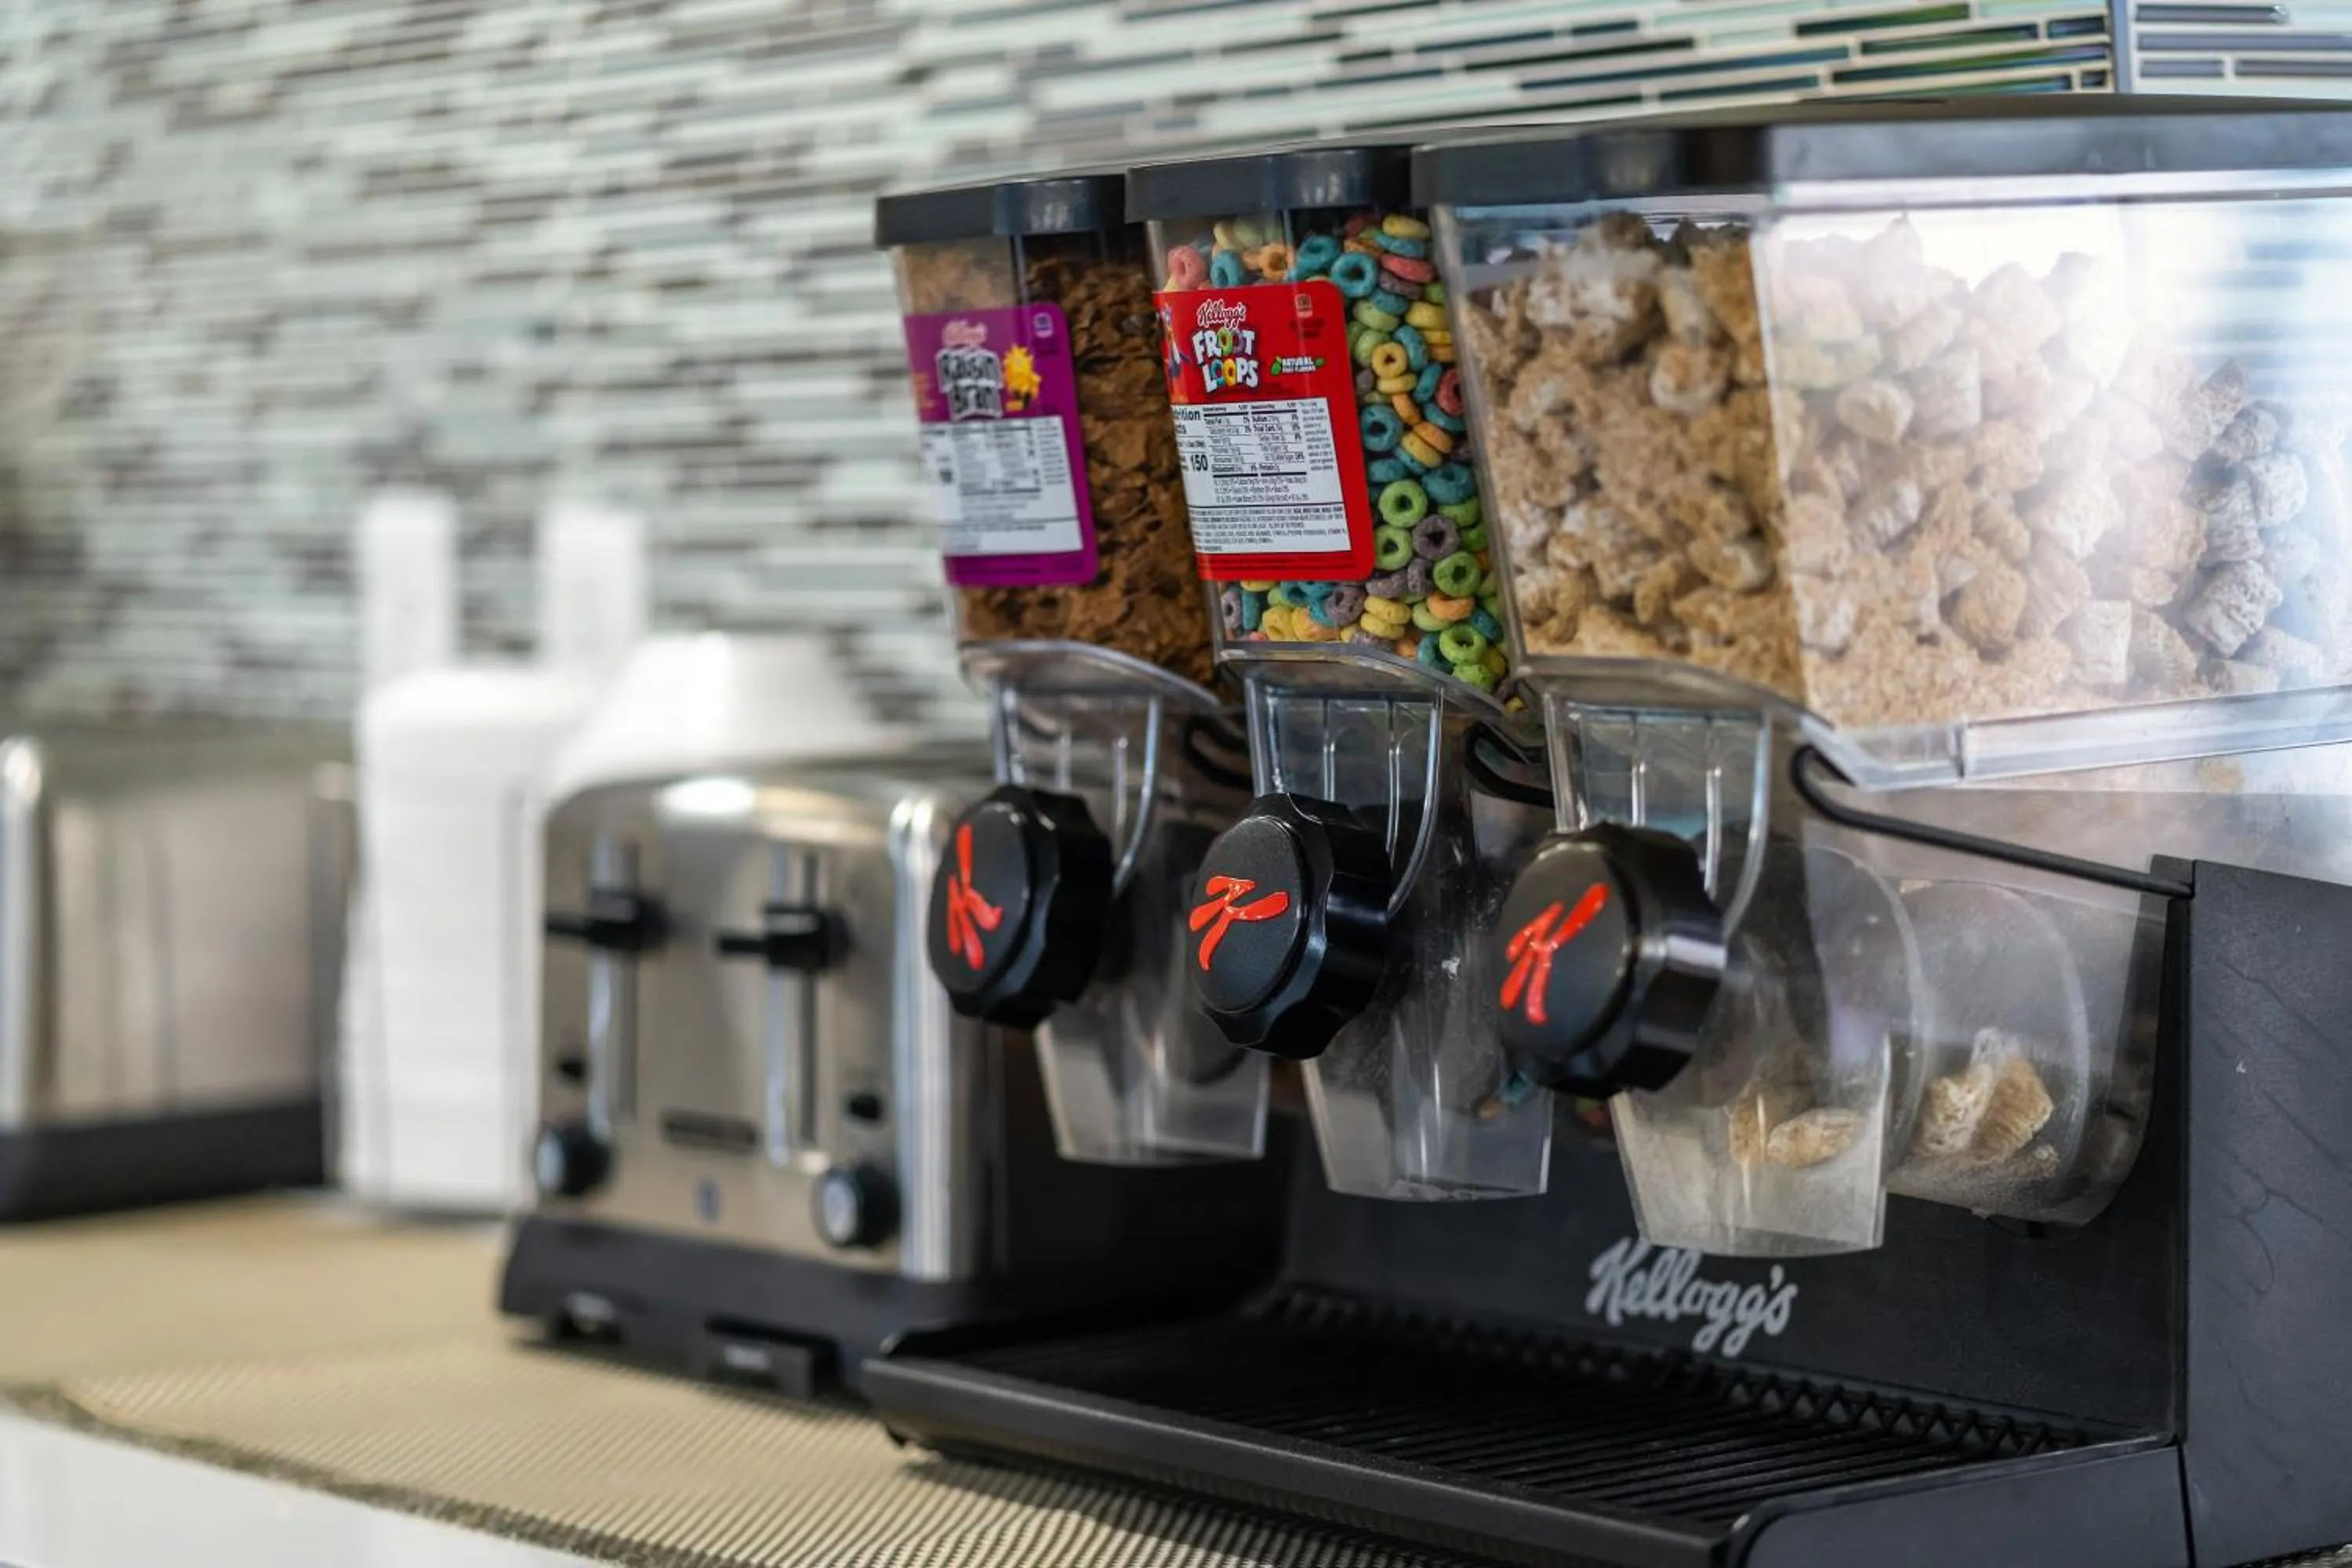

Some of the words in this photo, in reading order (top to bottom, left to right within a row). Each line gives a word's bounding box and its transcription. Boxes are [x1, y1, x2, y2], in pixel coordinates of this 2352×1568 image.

[1192, 327, 1256, 367] FROOT
[1201, 357, 1259, 393] LOOPS
[1190, 454, 1208, 471] 150
[1584, 1236, 1798, 1357] Kellogg's
